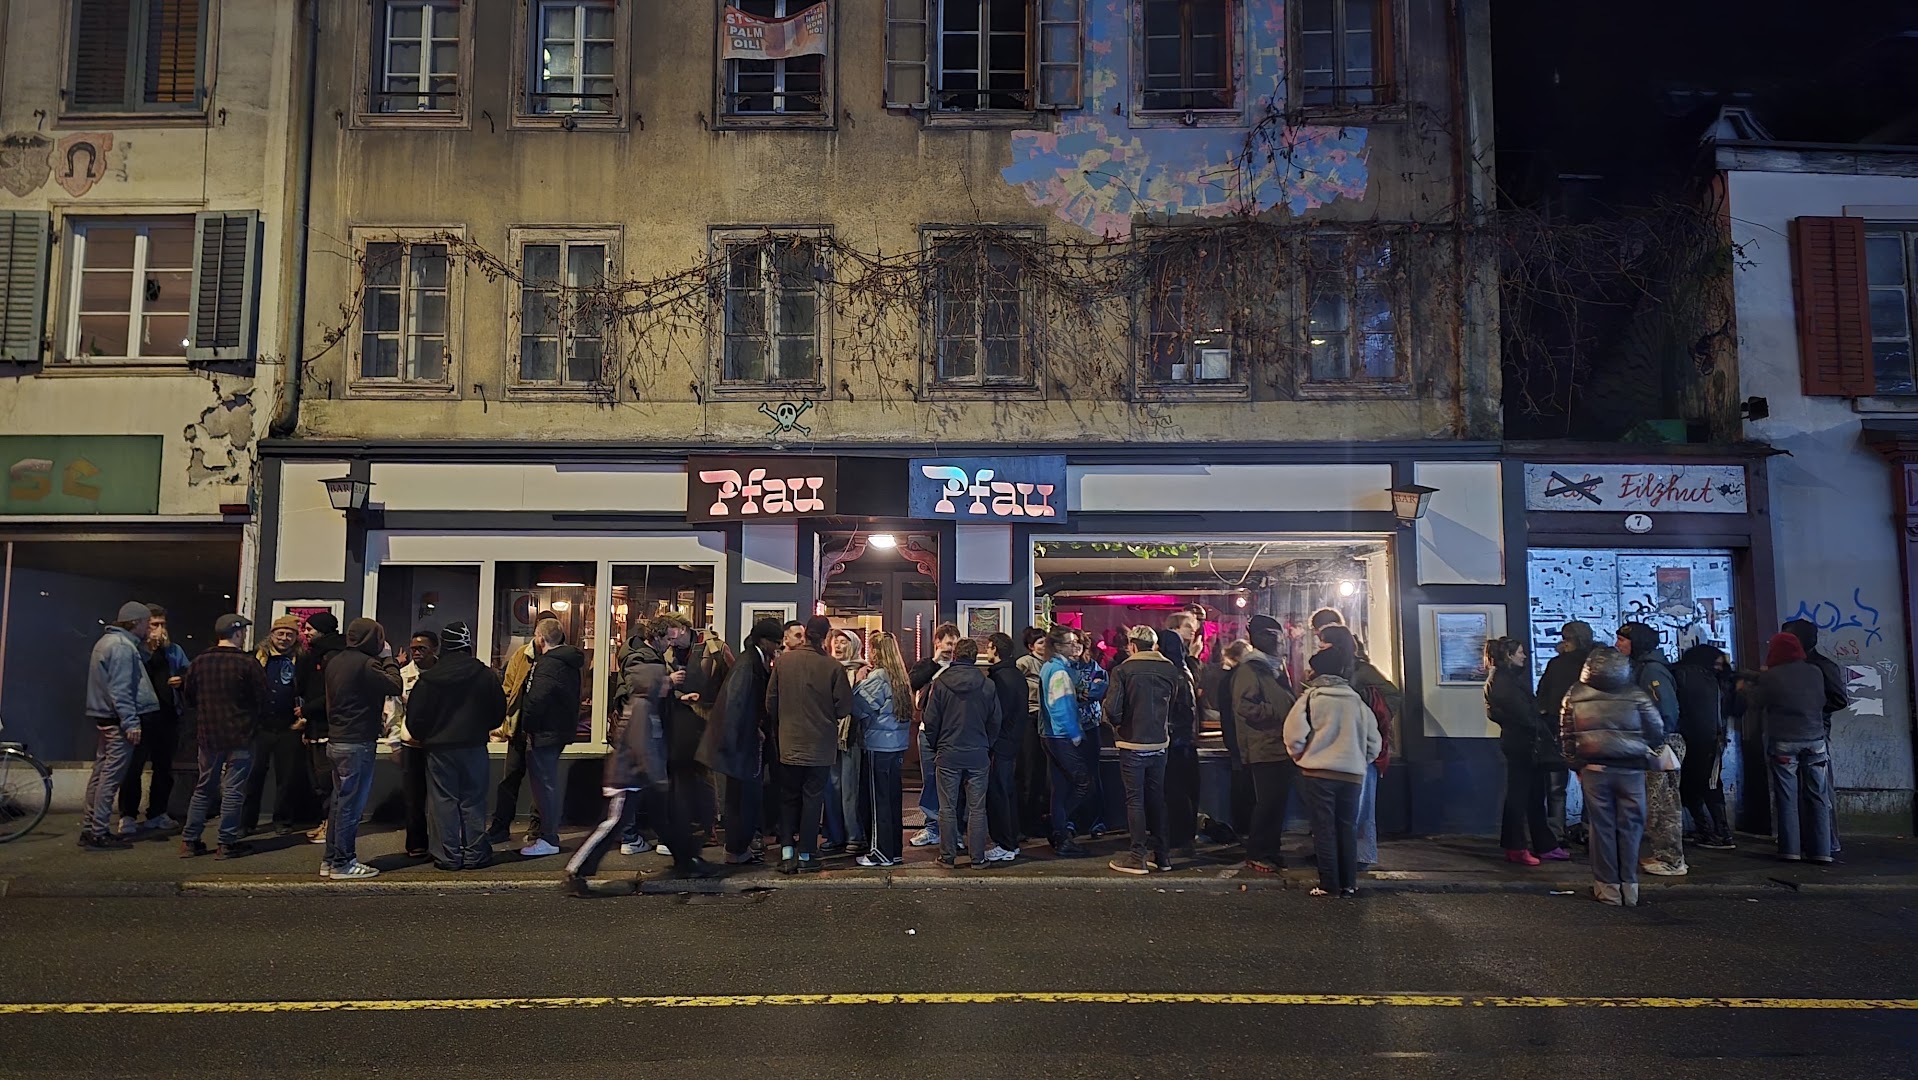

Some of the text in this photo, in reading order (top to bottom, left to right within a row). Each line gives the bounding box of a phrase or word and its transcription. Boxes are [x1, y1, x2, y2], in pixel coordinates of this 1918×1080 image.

[726, 12, 766, 25] STO
[729, 26, 763, 38] PALM
[733, 39, 761, 49] OIL!
[330, 484, 350, 493] BAR
[699, 468, 825, 517] Pfau
[922, 465, 1056, 518] Pfau
[1394, 494, 1417, 504] BAR
[1634, 515, 1643, 527] 7
